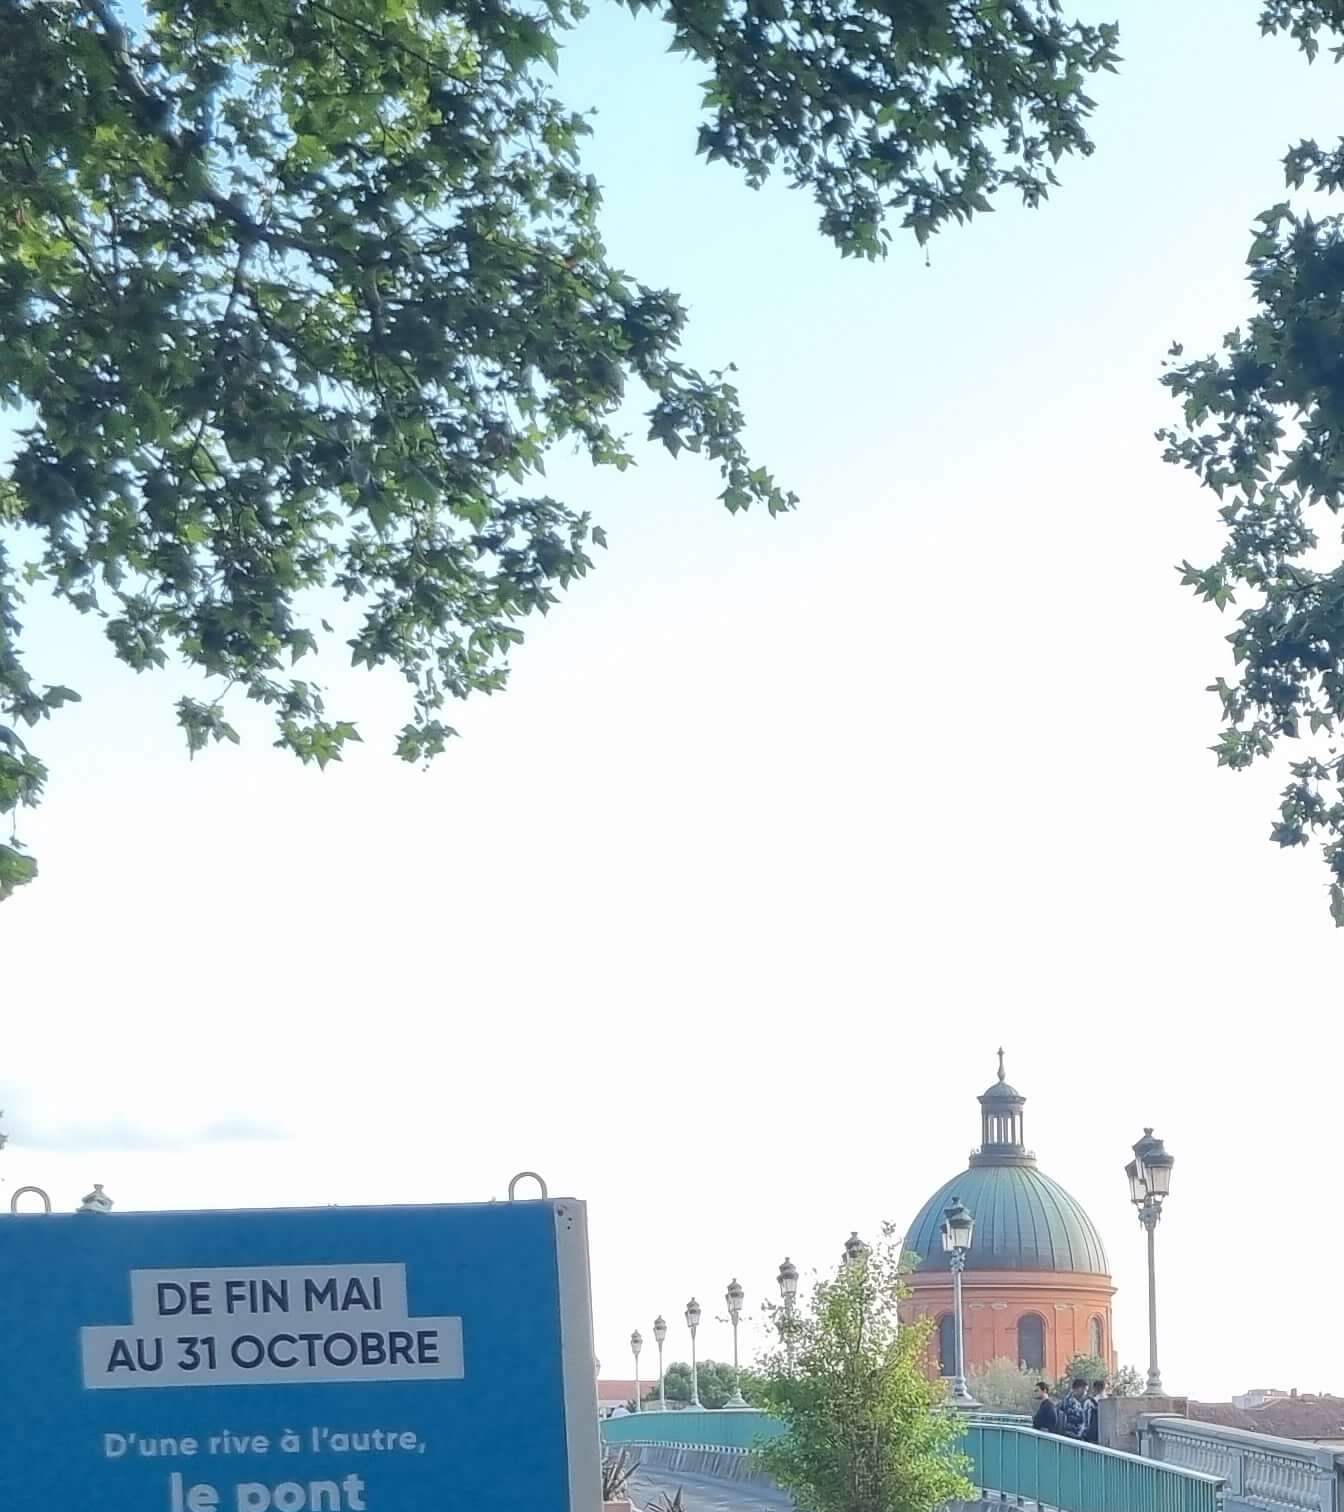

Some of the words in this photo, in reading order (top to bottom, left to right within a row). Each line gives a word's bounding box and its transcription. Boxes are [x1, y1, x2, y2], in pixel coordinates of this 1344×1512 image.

[157, 1282, 212, 1315] DE
[226, 1280, 288, 1313] FIN
[305, 1277, 381, 1311] MAI
[107, 1338, 162, 1372] AU
[178, 1337, 216, 1370] 31
[231, 1331, 439, 1368] OCTOBRE
[104, 1433, 198, 1458] D'une
[209, 1430, 269, 1454] rive
[280, 1429, 300, 1452] à
[312, 1427, 425, 1453] l'autre,
